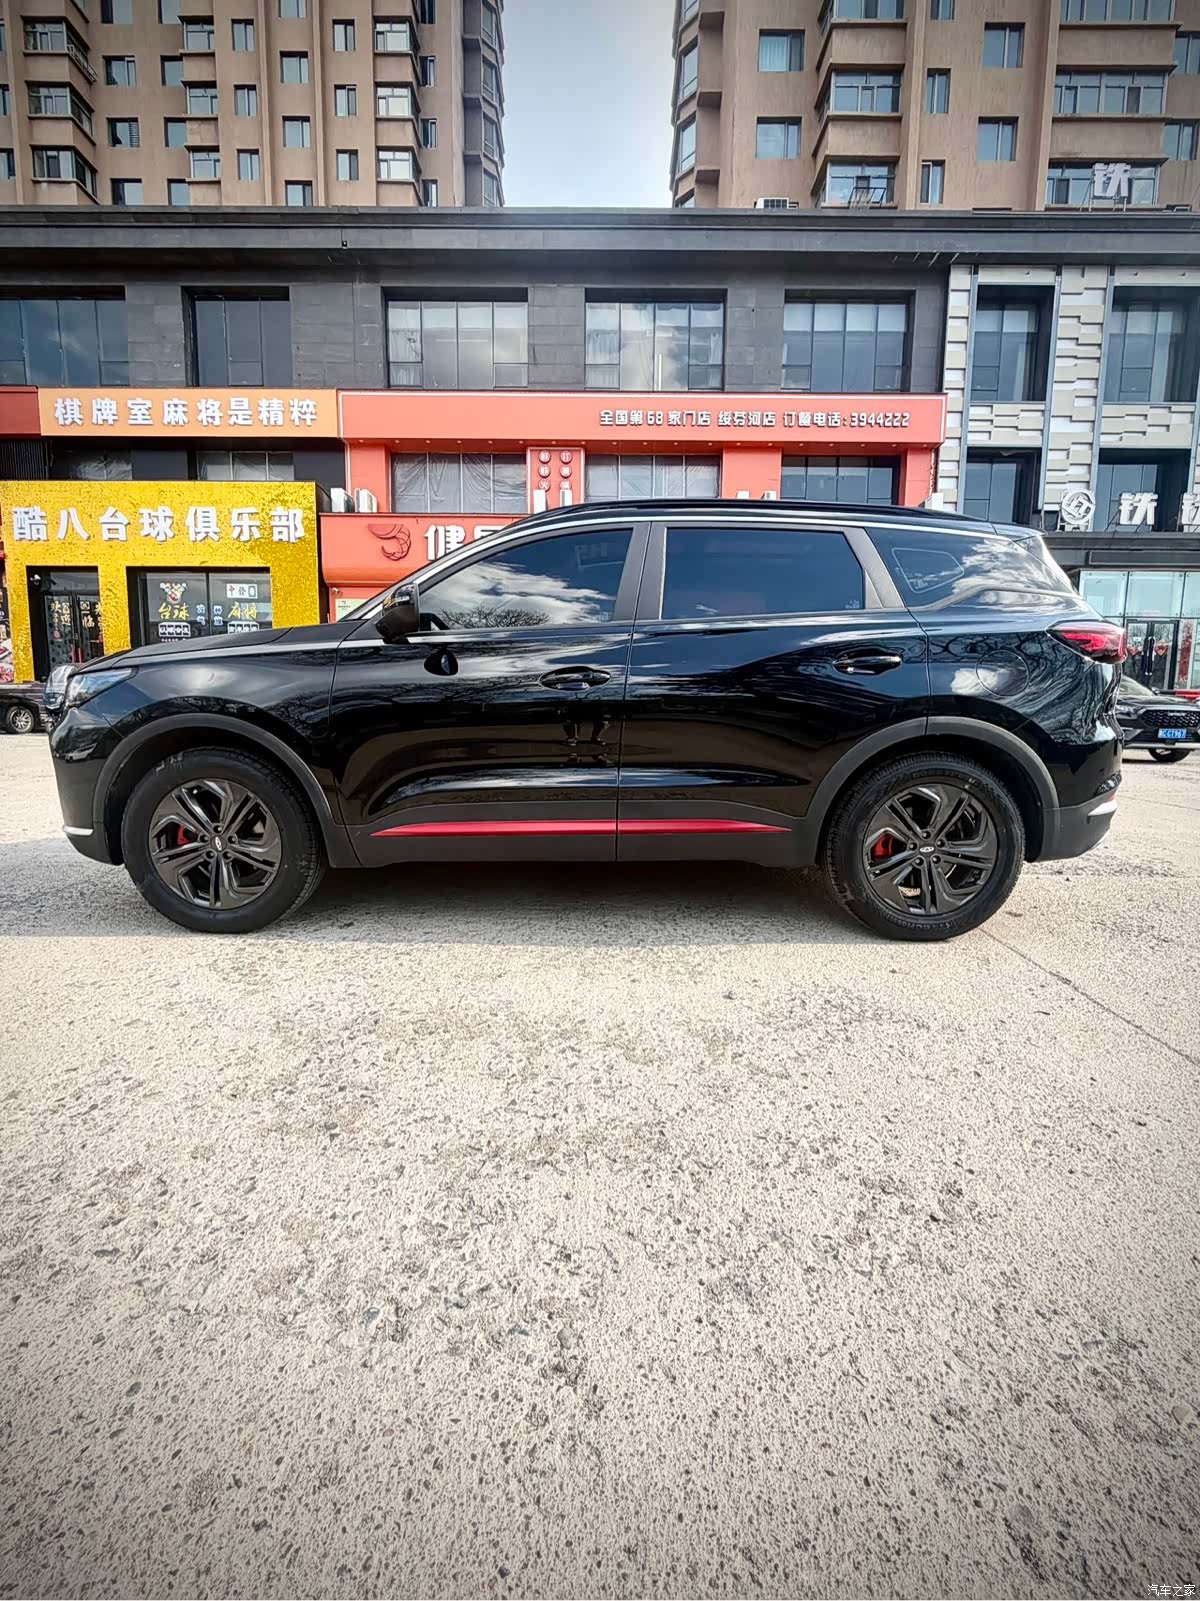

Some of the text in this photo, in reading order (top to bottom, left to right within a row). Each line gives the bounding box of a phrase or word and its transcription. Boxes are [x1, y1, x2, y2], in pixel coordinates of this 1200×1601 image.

[54, 397, 318, 427] 棋牌室麻将是精粹
[717, 410, 777, 428] 绥芬河店
[11, 506, 306, 544] 酷八台球俱乐部
[158, 602, 189, 620] 台球
[228, 601, 257, 620] 麻将
